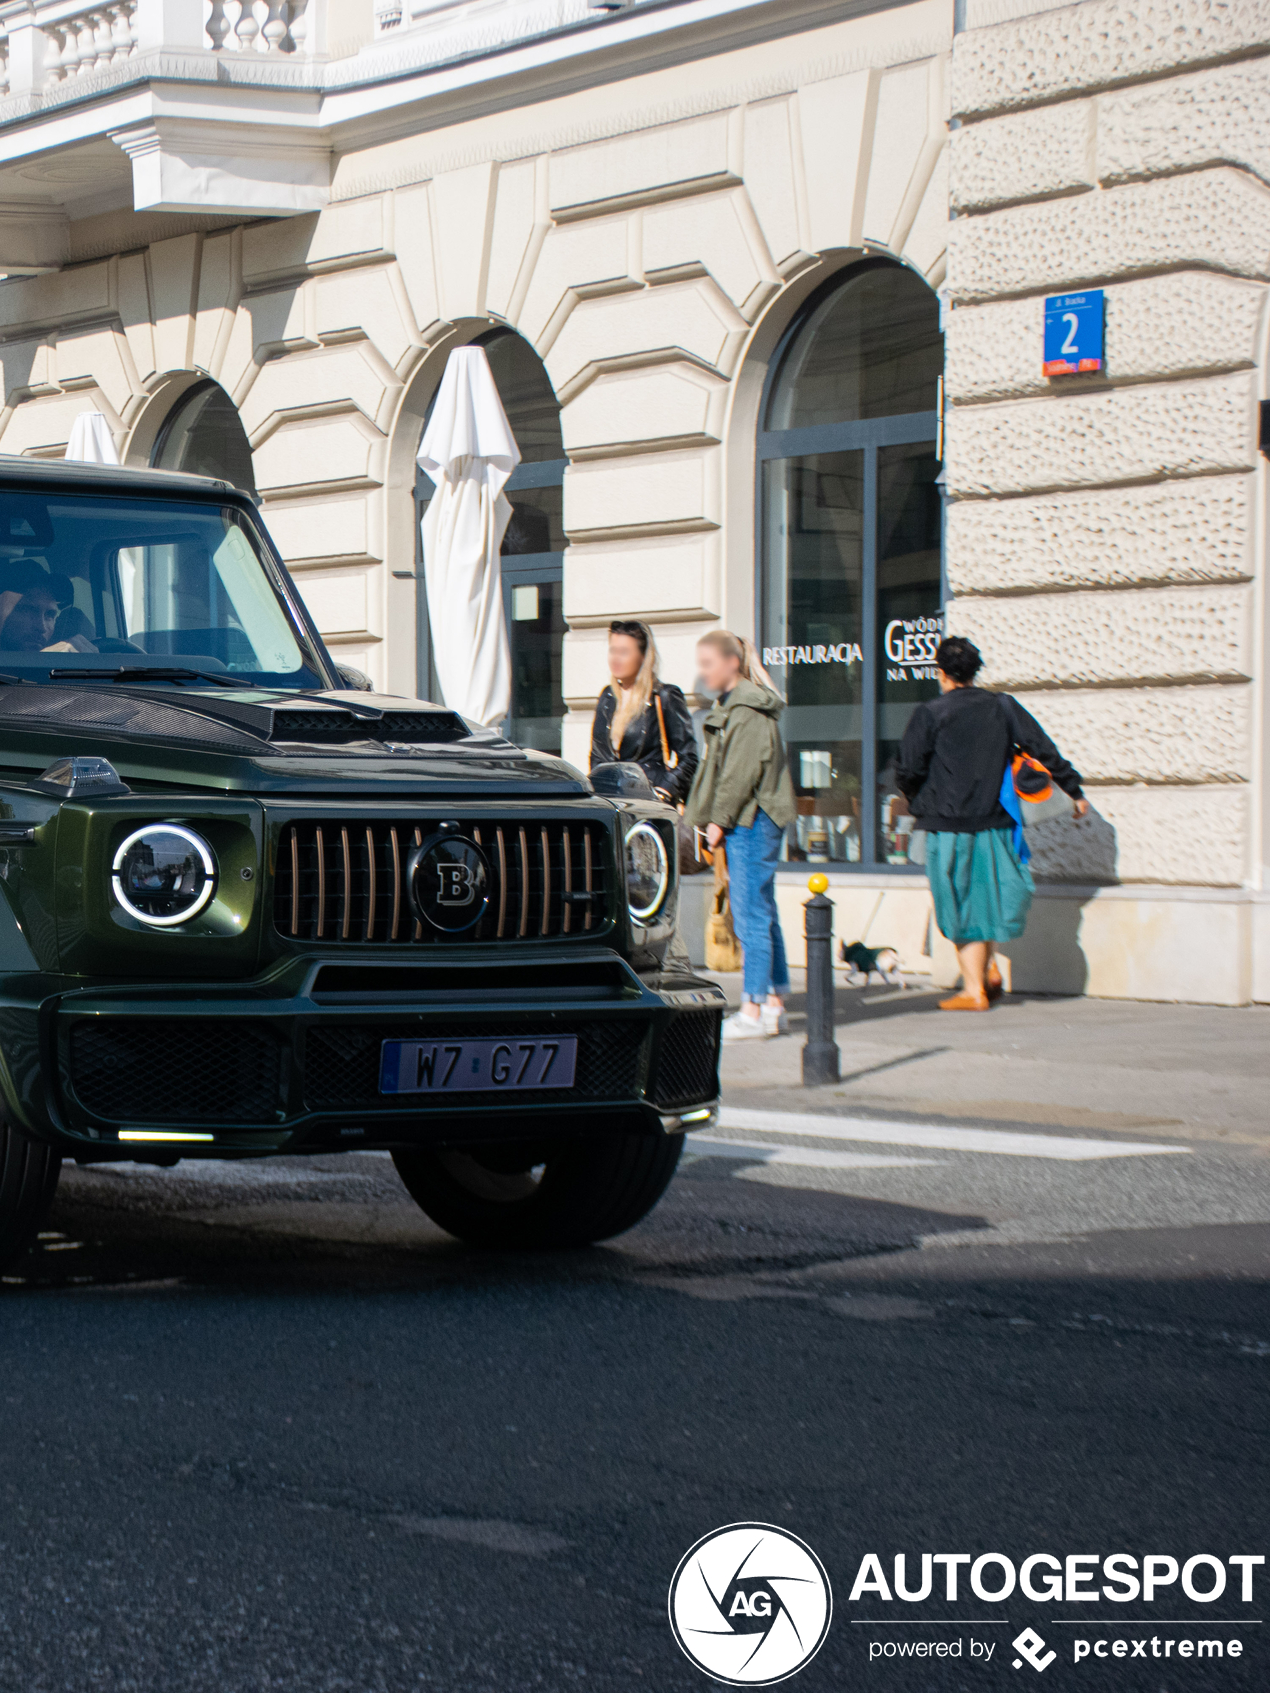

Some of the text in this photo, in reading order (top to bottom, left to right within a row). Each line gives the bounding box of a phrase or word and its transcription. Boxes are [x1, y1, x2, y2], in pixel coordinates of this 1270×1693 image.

[1060, 312, 1079, 355] 2
[763, 643, 864, 666] RESTAURACJA
[886, 667, 908, 681] NA
[436, 863, 475, 906] B
[416, 1040, 560, 1087] W7 G77
